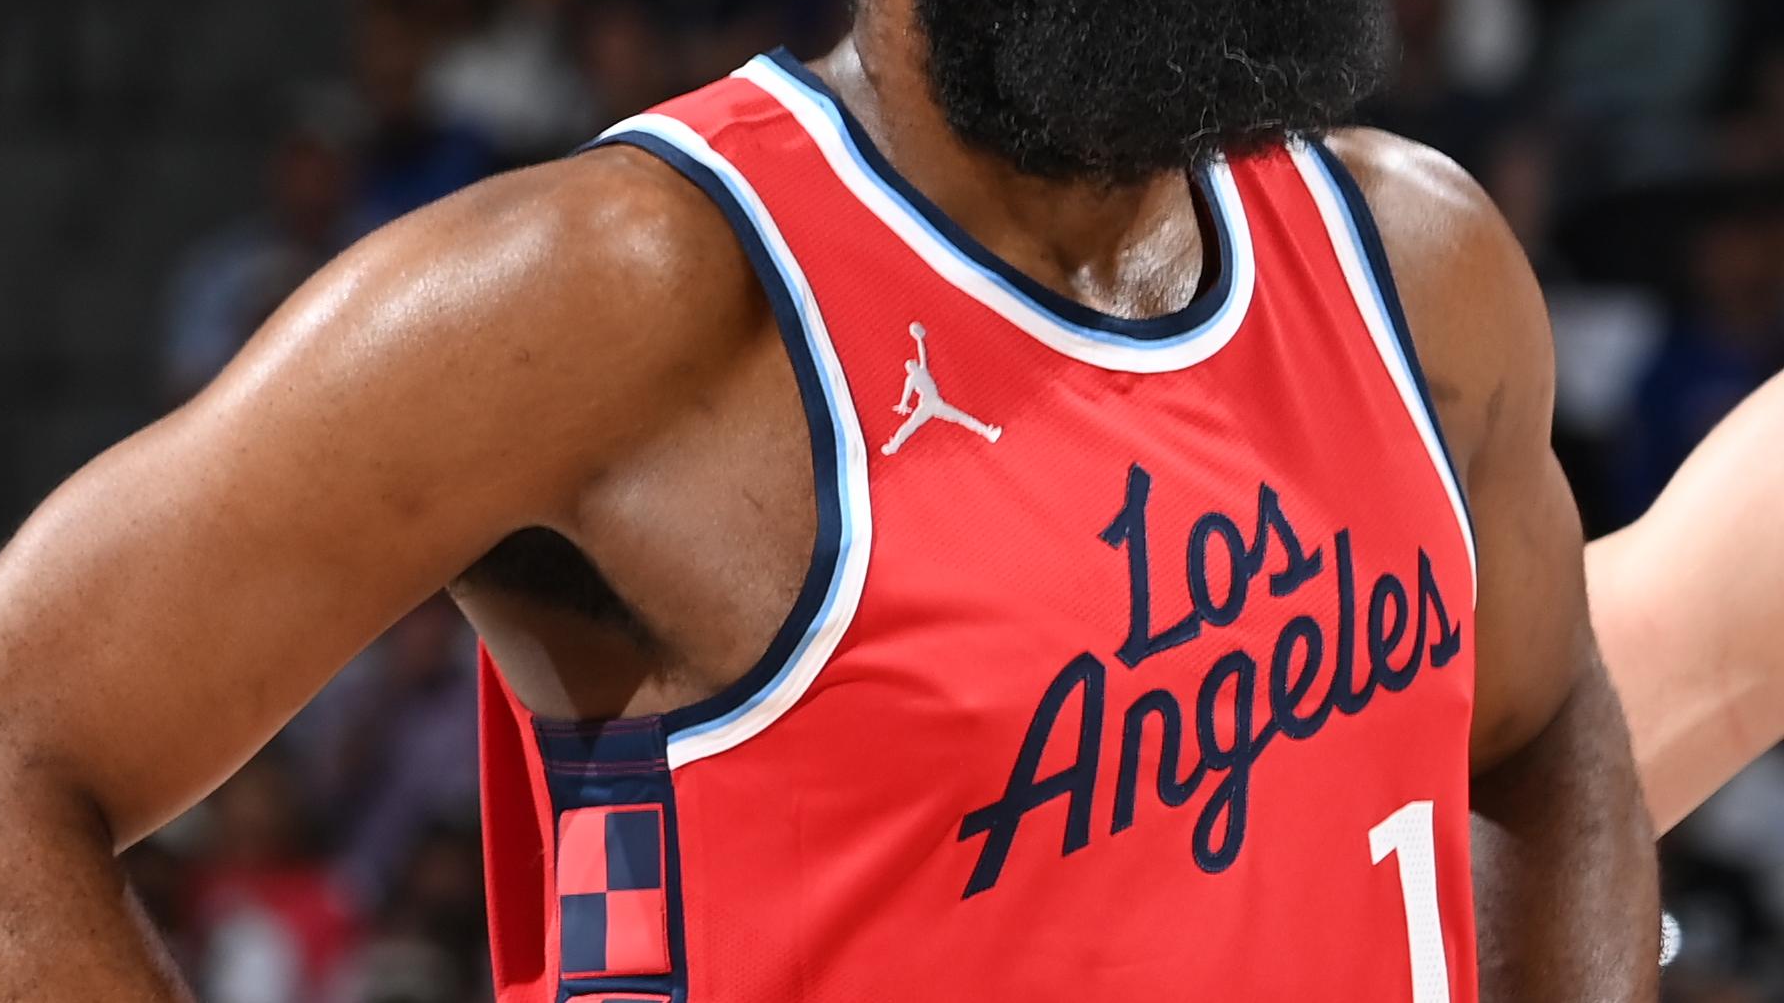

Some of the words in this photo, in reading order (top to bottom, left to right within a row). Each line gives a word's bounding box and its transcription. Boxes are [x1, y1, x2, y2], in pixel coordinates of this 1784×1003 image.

[1100, 461, 1323, 668] Los
[957, 528, 1461, 901] Angeles
[1368, 800, 1451, 1003] 1
